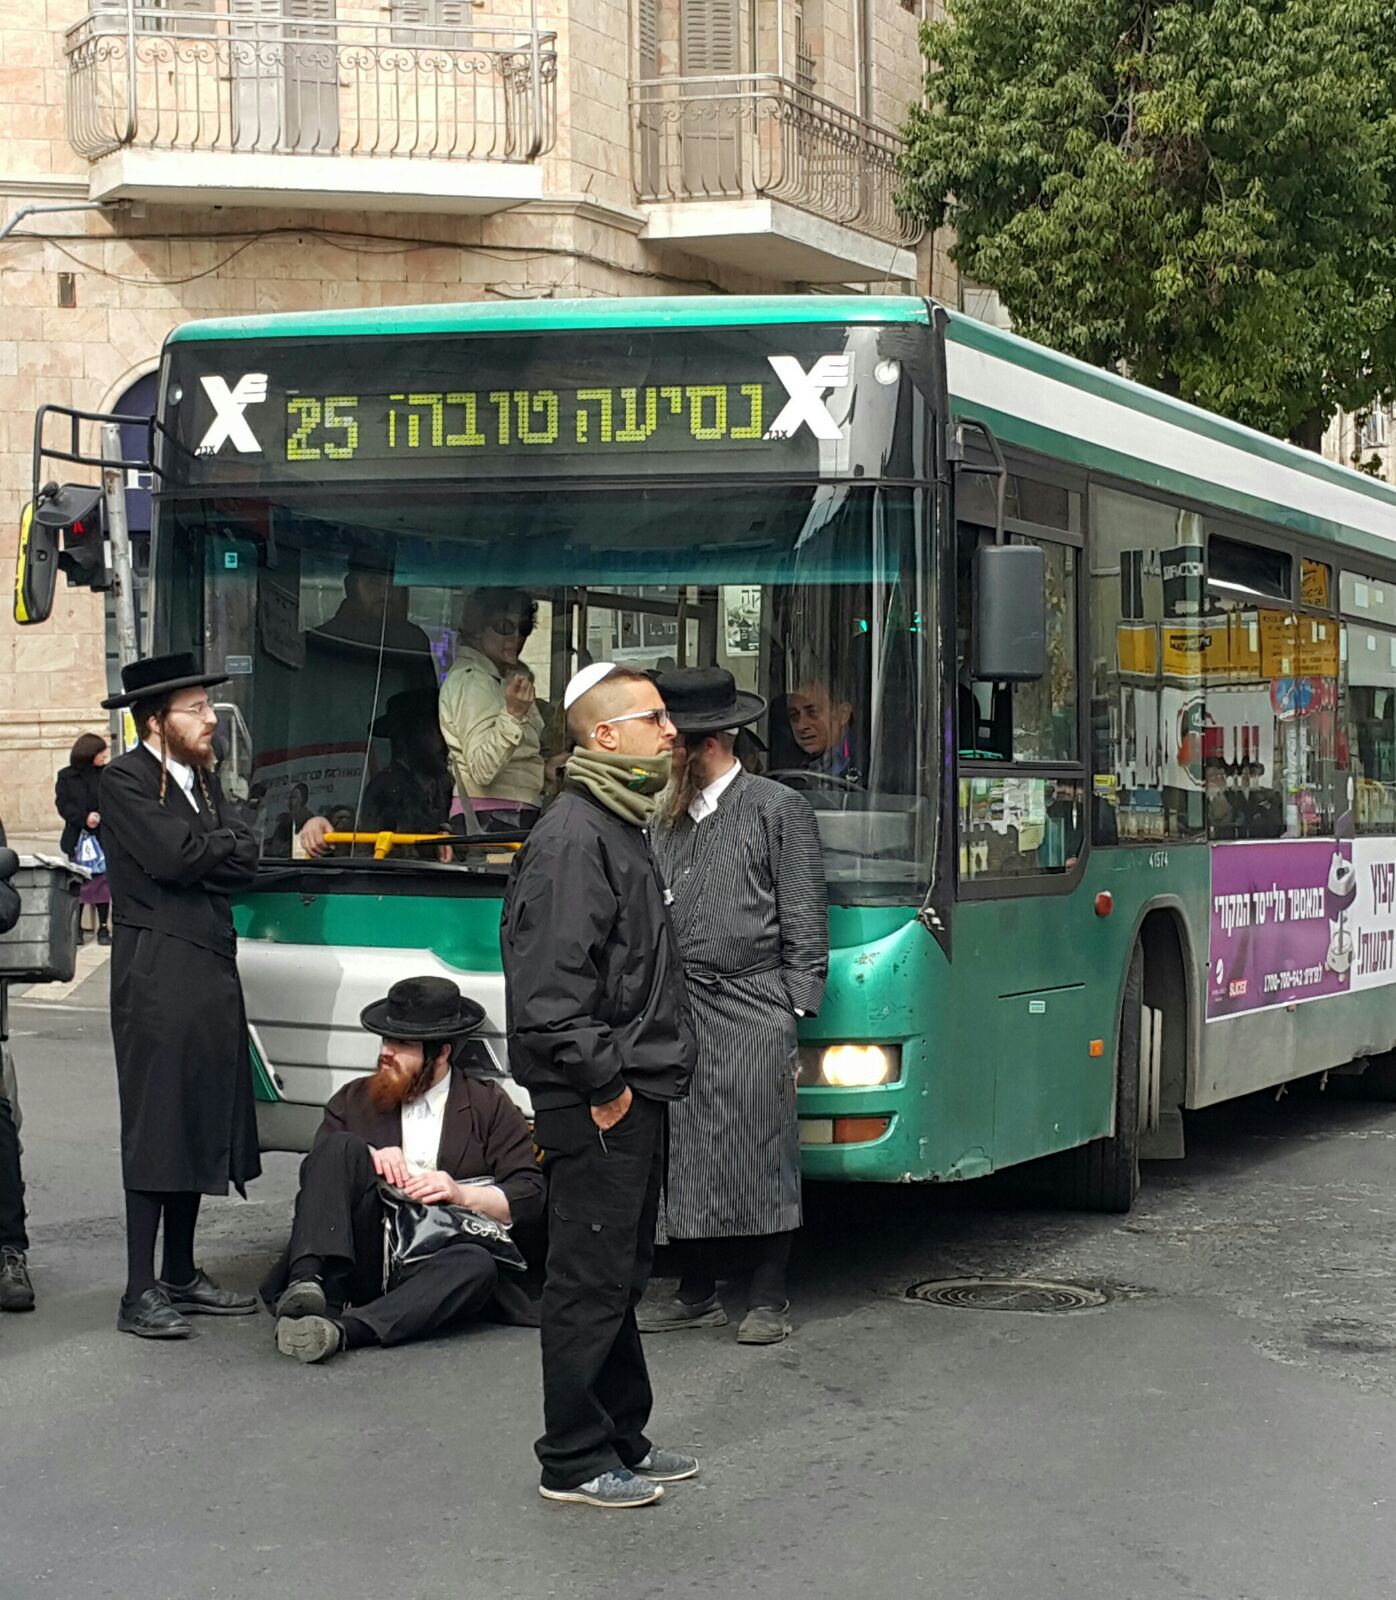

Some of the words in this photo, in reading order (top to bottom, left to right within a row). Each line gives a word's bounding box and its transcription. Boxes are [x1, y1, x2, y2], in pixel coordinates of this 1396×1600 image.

[286, 395, 359, 461] 25
[576, 383, 763, 443] נסיעה
[1148, 851, 1169, 868] 41574
[1370, 862, 1395, 915] קצוץ
[1214, 893, 1251, 937] המקורי
[1228, 979, 1248, 997] SLICER
